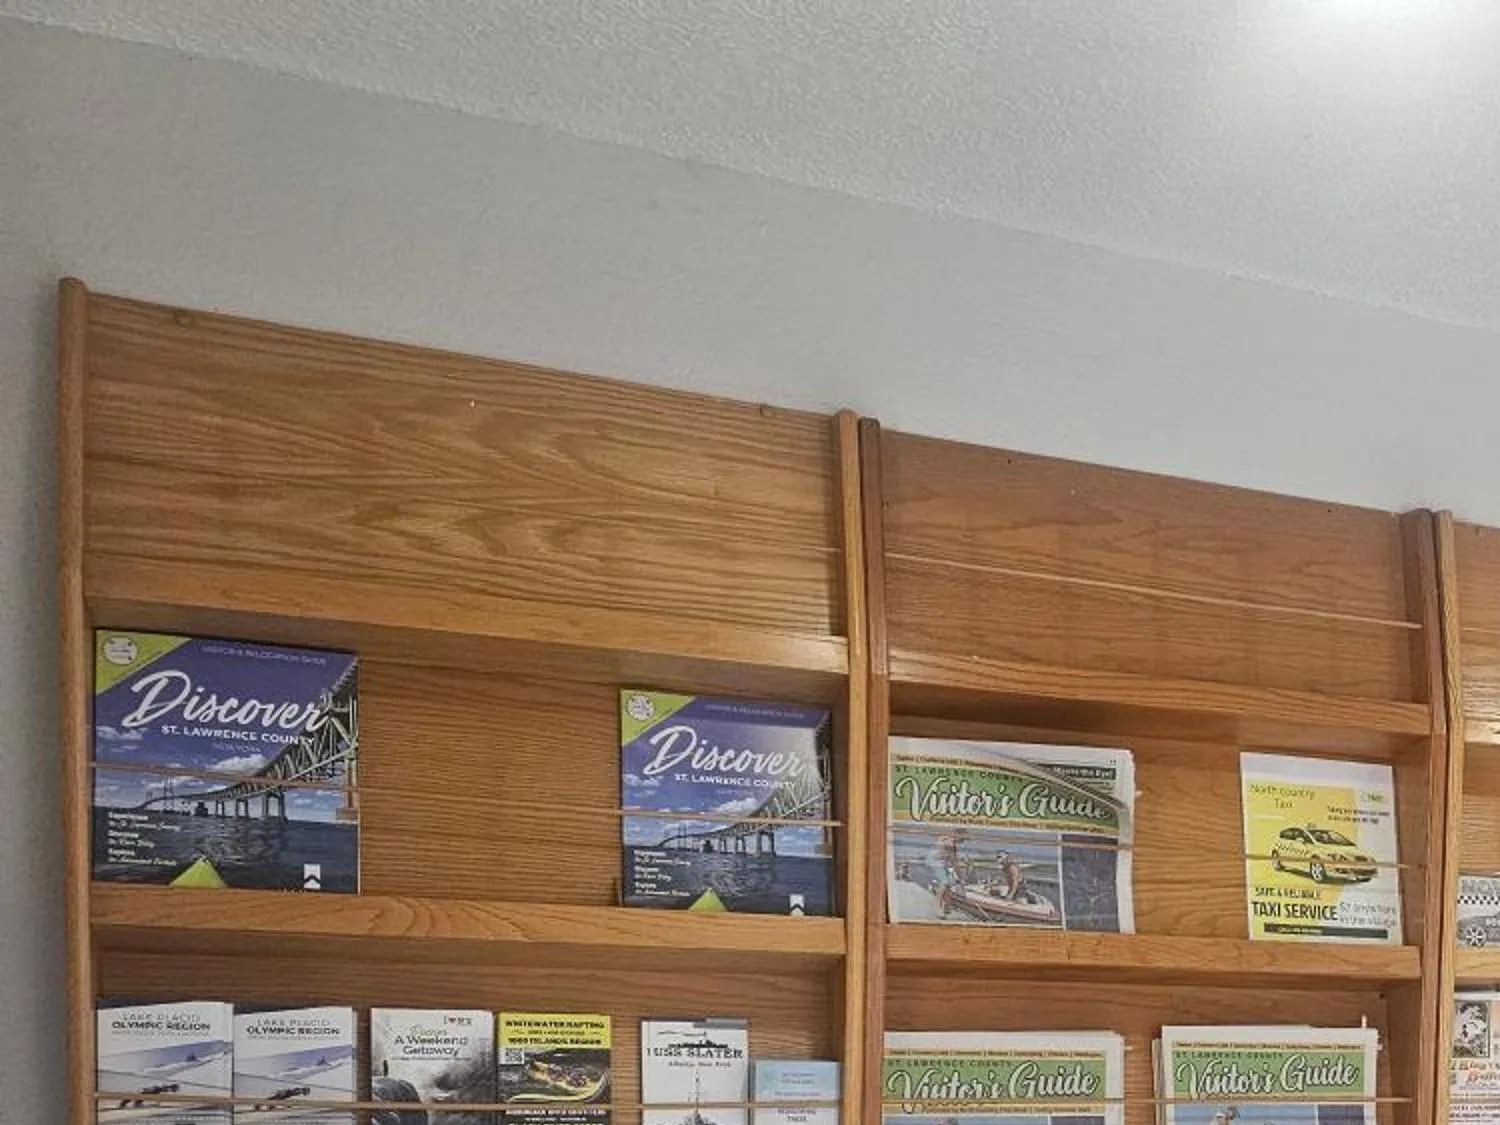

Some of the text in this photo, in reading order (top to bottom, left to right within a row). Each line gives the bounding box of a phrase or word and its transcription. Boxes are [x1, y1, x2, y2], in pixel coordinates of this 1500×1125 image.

[122, 669, 330, 733] Discover
[161, 725, 315, 745] ST. LAWRENCE COUNTY
[643, 725, 806, 776] Discover
[692, 774, 751, 786] LAWRENCE
[895, 775, 1110, 821] Visitor's Guide
[1252, 901, 1281, 918] TAXI
[1285, 903, 1339, 921] SERVICE
[157, 1012, 200, 1022] PLACID
[289, 1018, 331, 1028] PLACID
[112, 1021, 211, 1032] OLYMPIC REGION
[246, 1026, 340, 1036] OLYMPIC REGION
[395, 1035, 468, 1045] A Weekend
[403, 1045, 462, 1057] Getaway
[685, 1048, 743, 1059] SLATER
[1176, 1053, 1359, 1100] Visitor's Guide
[887, 1059, 1100, 1113] Visitor's Guide
